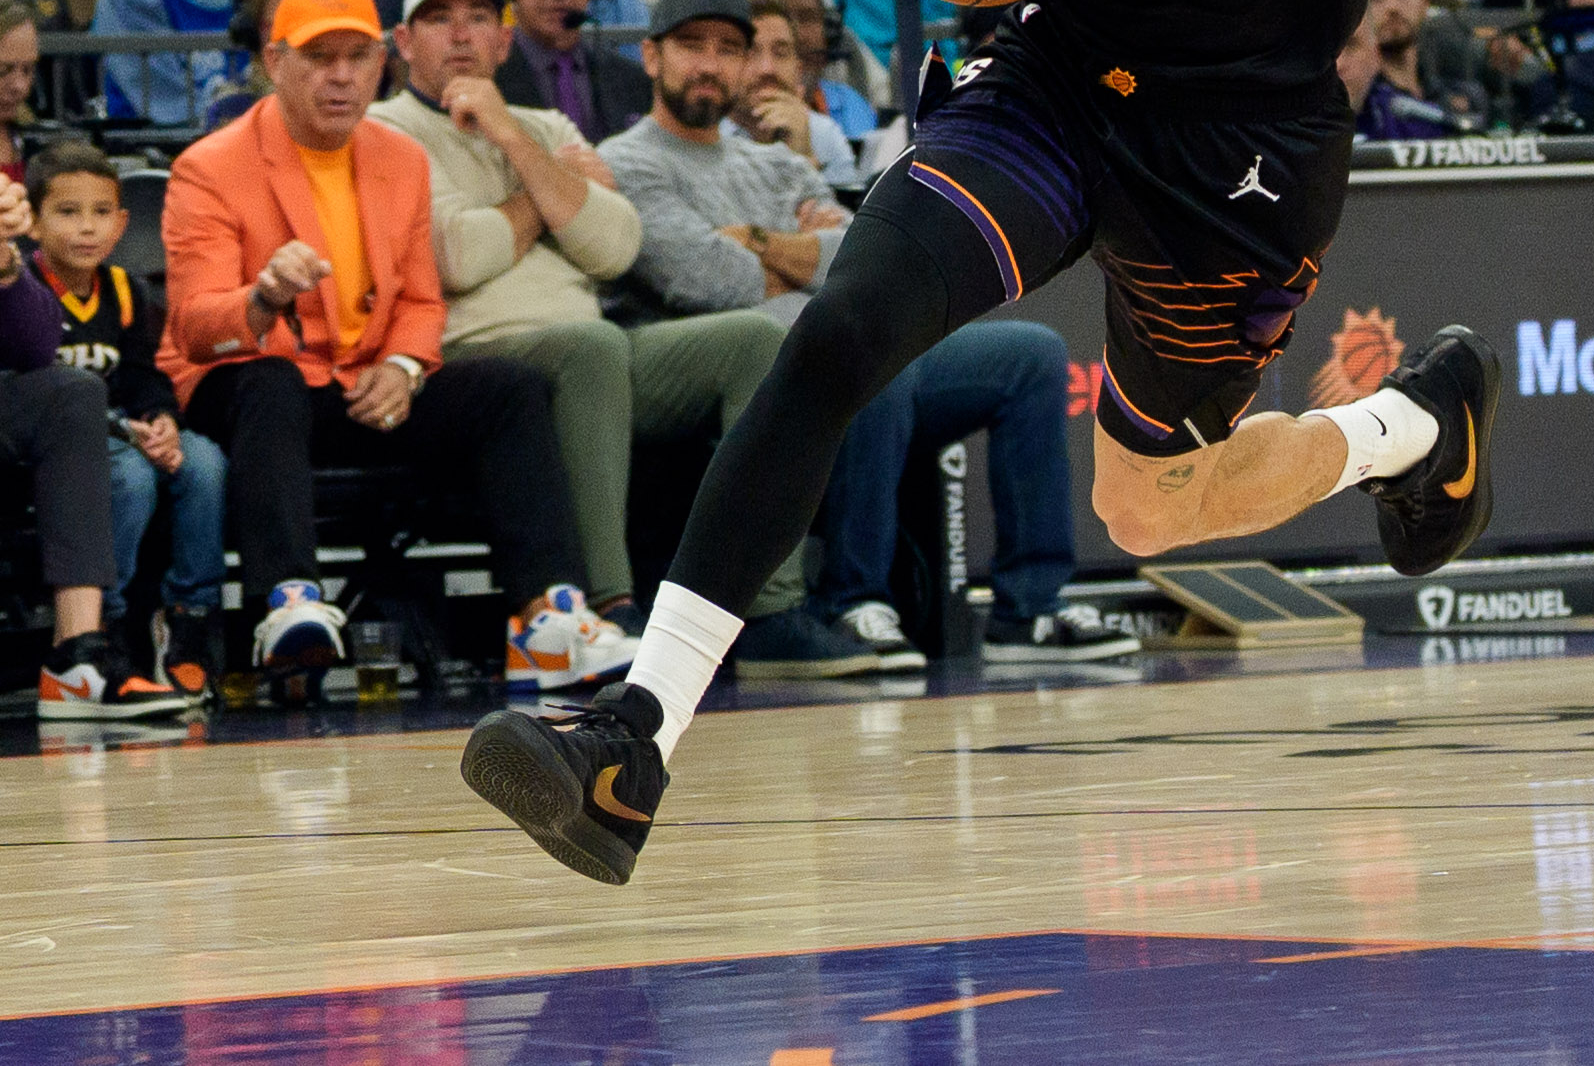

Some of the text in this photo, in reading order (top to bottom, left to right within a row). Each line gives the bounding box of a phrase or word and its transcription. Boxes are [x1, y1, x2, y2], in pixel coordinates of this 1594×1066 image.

[1431, 137, 1547, 165] FANDUEL
[946, 482, 968, 594] FANDUEL
[1457, 589, 1572, 621] FANDUEL
